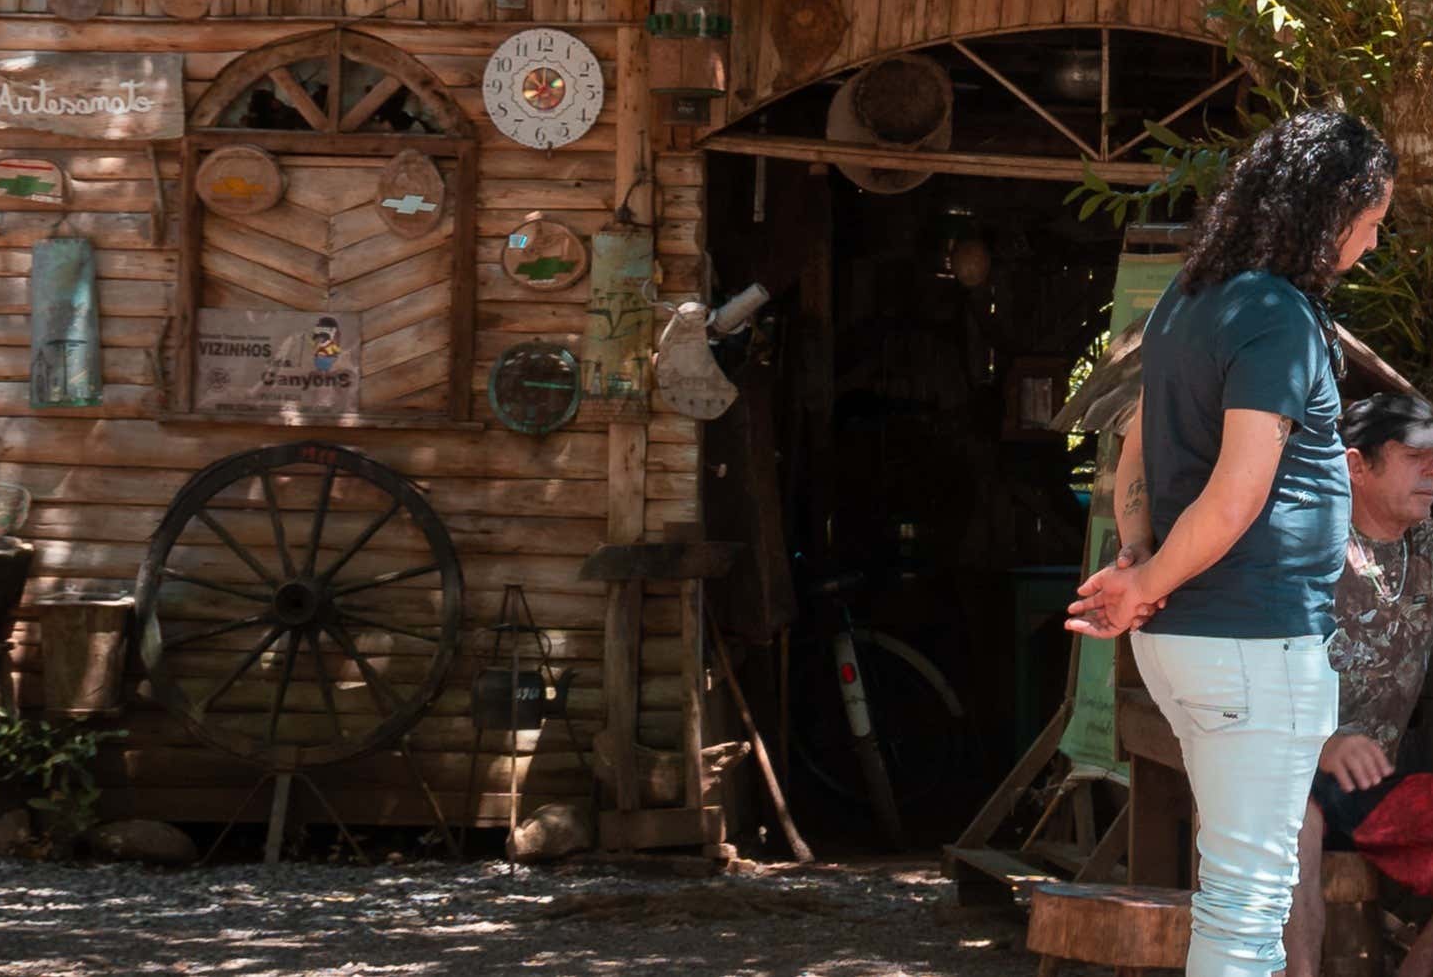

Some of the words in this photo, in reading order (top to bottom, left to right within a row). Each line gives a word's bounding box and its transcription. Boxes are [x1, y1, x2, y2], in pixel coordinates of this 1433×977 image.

[516, 43, 528, 57] 11
[538, 36, 554, 52] 12
[495, 57, 512, 72] 10
[198, 342, 272, 358] VIZINHOS
